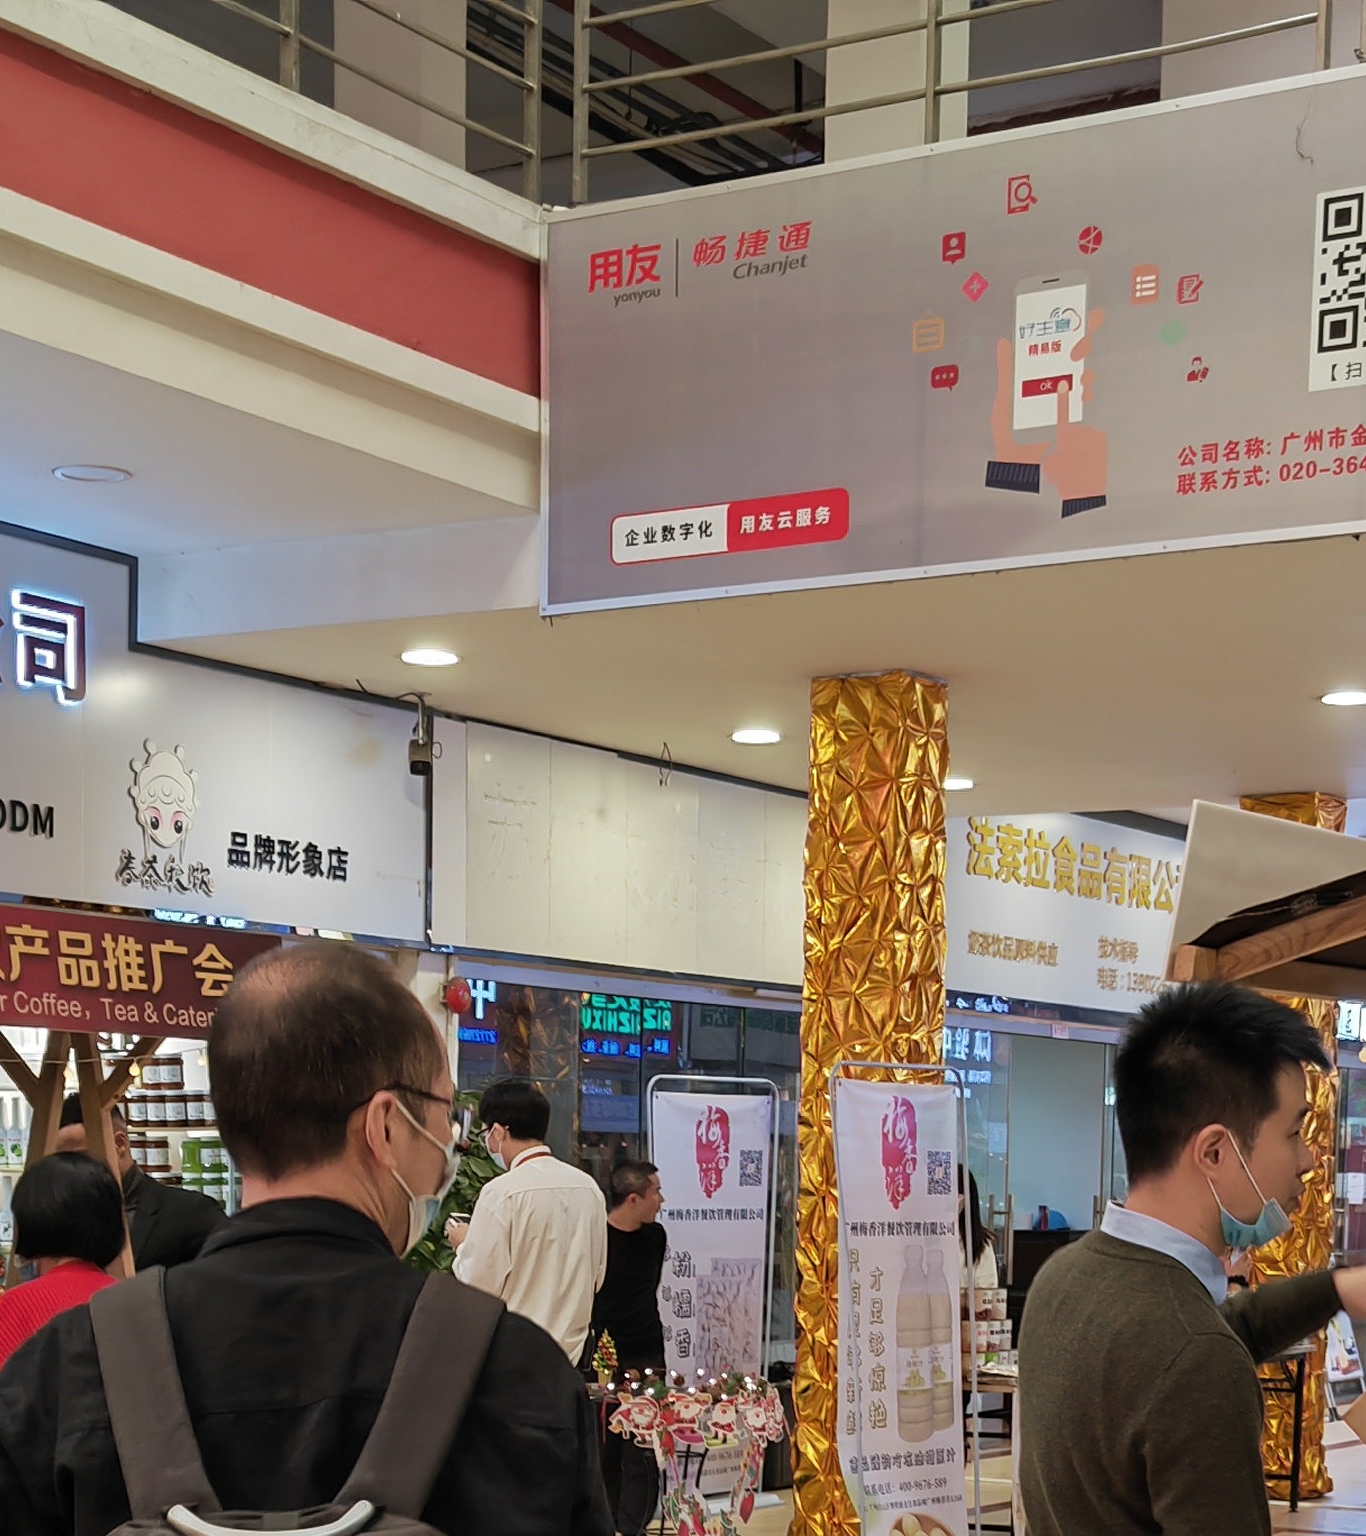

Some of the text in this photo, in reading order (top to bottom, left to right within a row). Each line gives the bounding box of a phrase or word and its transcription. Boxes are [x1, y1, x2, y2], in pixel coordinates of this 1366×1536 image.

[692, 220, 813, 269] 畅捷通
[588, 242, 662, 293] 用友
[733, 252, 808, 281] Chanjet
[613, 285, 661, 307] yonyou
[624, 519, 714, 548] 企业数字化
[739, 505, 832, 535] 用友云服务
[226, 831, 350, 883] 品牌形象店
[100, 996, 139, 1023] Tea
[144, 1000, 158, 1024] &
[162, 1003, 218, 1029] Cater
